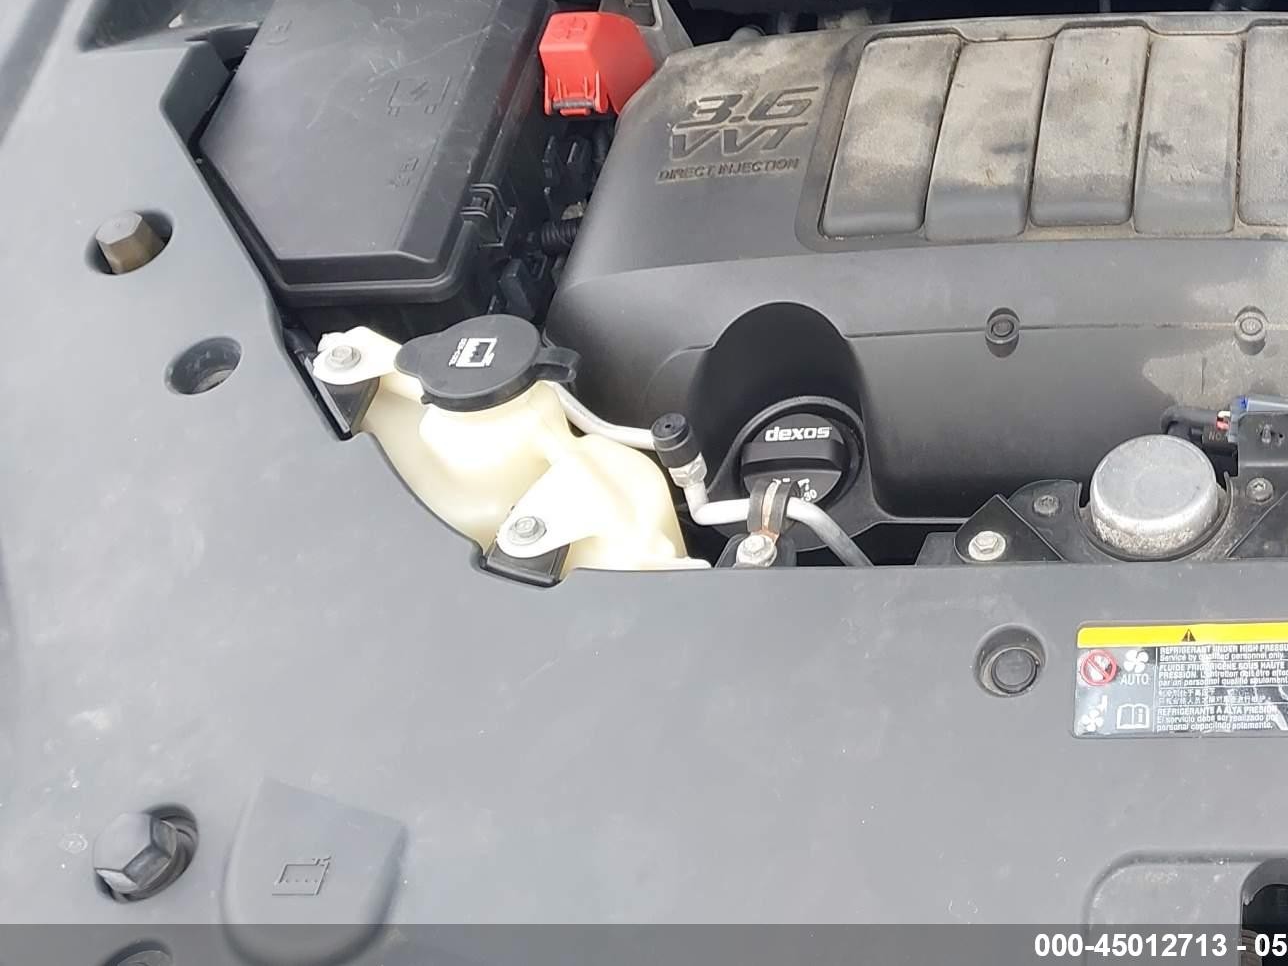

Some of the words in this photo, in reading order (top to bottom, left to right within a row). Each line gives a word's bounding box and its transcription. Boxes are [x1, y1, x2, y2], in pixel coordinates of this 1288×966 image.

[675, 86, 819, 131] 3.6
[671, 123, 809, 160] VVT
[658, 164, 714, 180] DIRECT
[718, 158, 800, 175] INJECTION
[764, 425, 830, 442] dexos
[1159, 645, 1211, 655] REFRIGERANT
[1212, 645, 1238, 653] UNDER
[1240, 644, 1259, 652] HIGH
[1159, 654, 1187, 662] Service
[1199, 652, 1230, 661] qualified
[1231, 651, 1267, 660] personnel
[1159, 663, 1186, 672] FLUIDE
[1238, 661, 1259, 670] SOUS
[1260, 661, 1285, 670] HAUTE
[1120, 673, 1149, 685] AUTO
[1157, 706, 1215, 716] REFRIGERANTE
[1223, 705, 1242, 715] ALTA
